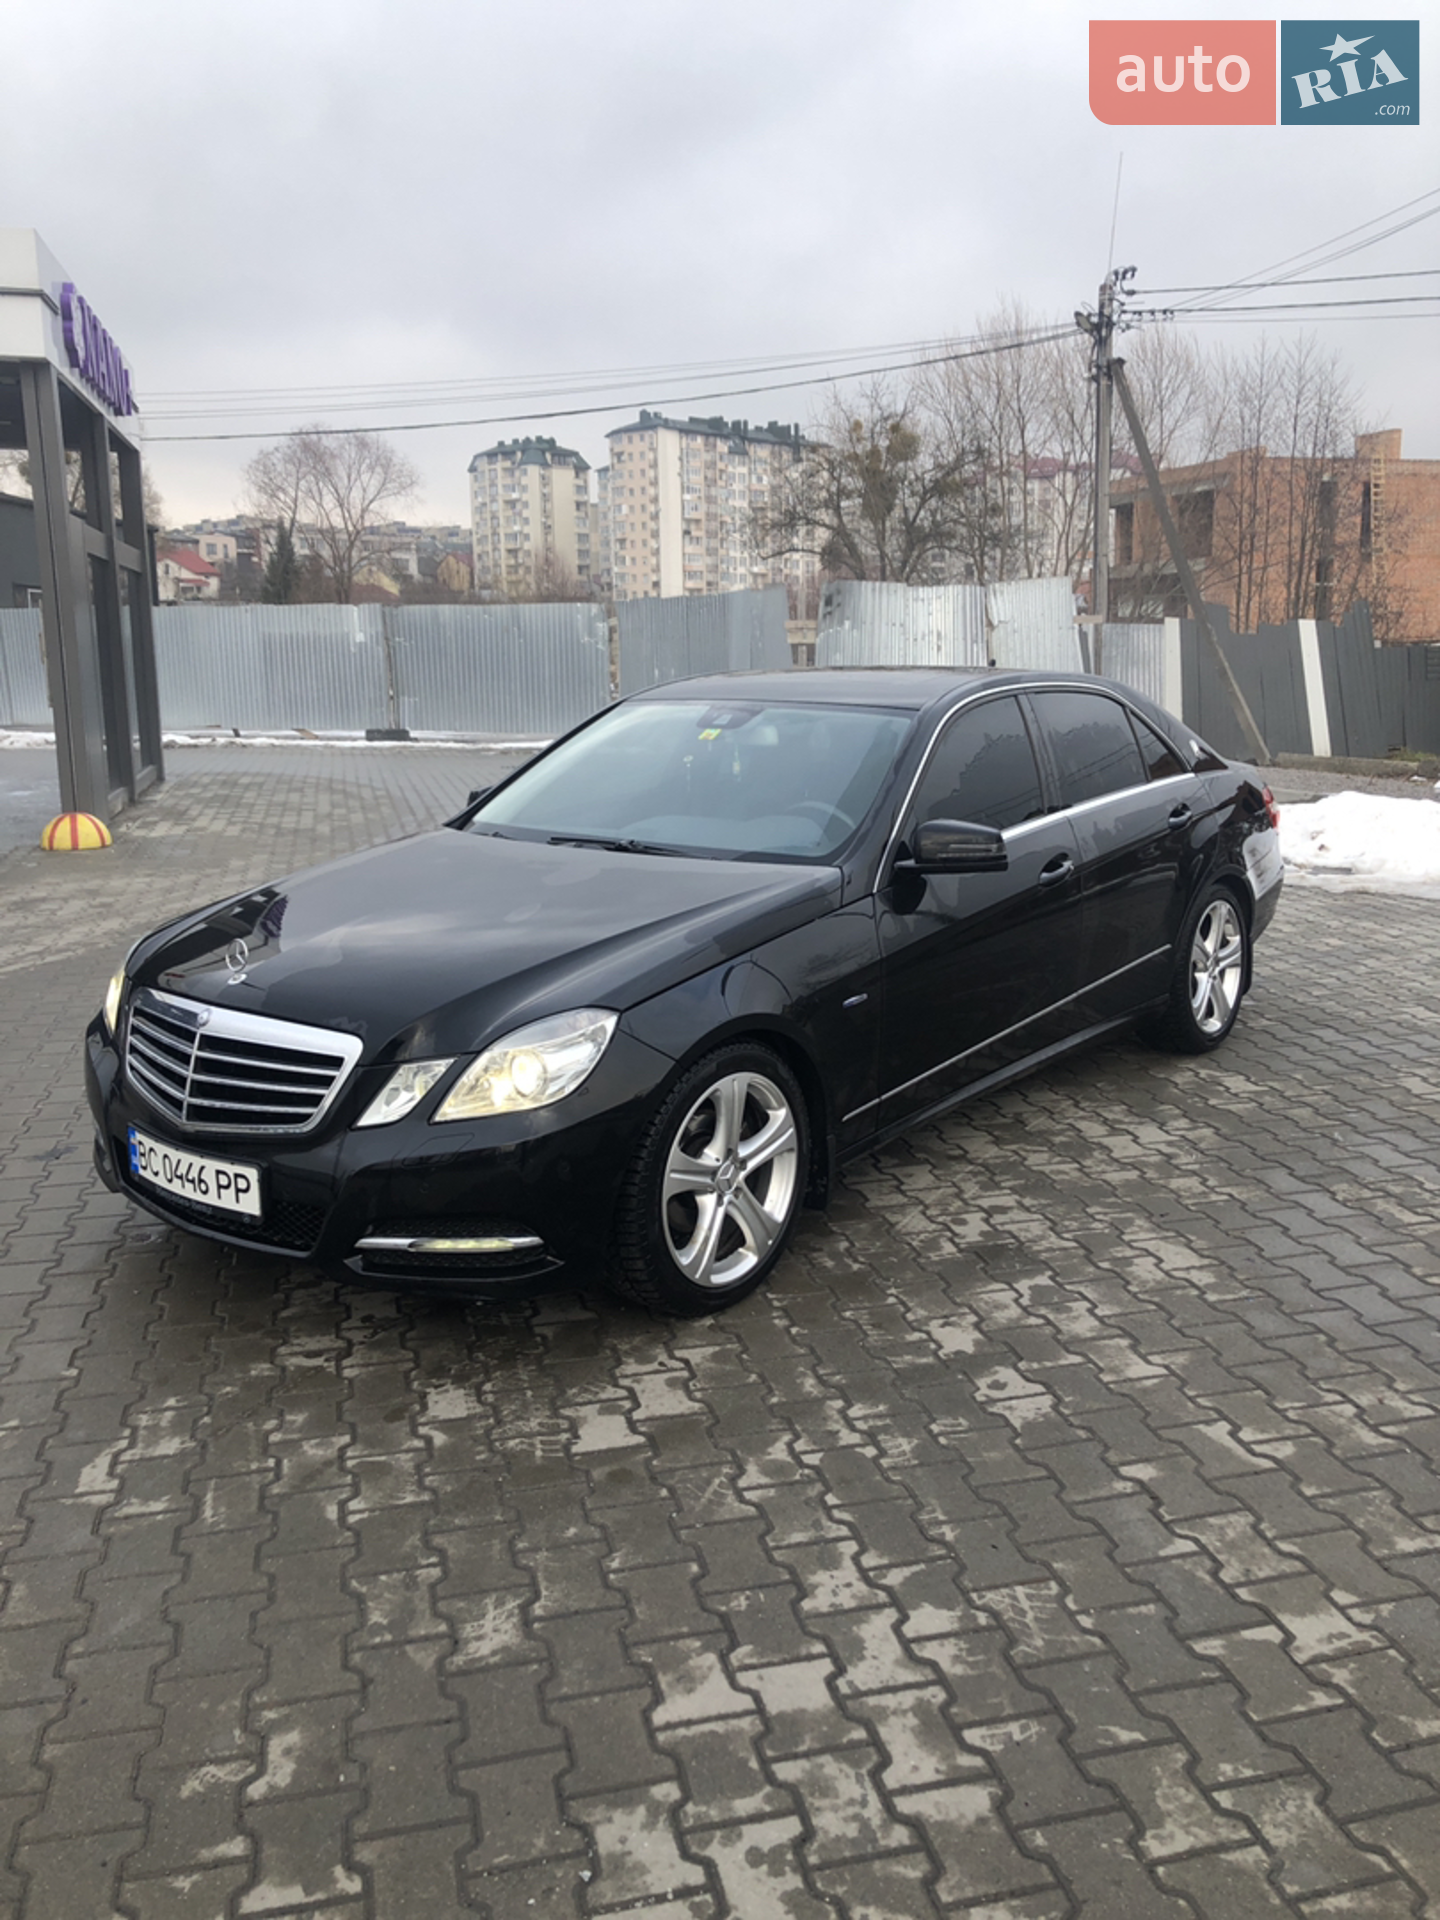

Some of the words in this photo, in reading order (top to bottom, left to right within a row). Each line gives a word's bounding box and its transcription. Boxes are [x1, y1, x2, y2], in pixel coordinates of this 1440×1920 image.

[138, 1140, 160, 1177] BC
[162, 1153, 210, 1195] 0446
[215, 1169, 251, 1204] PP
